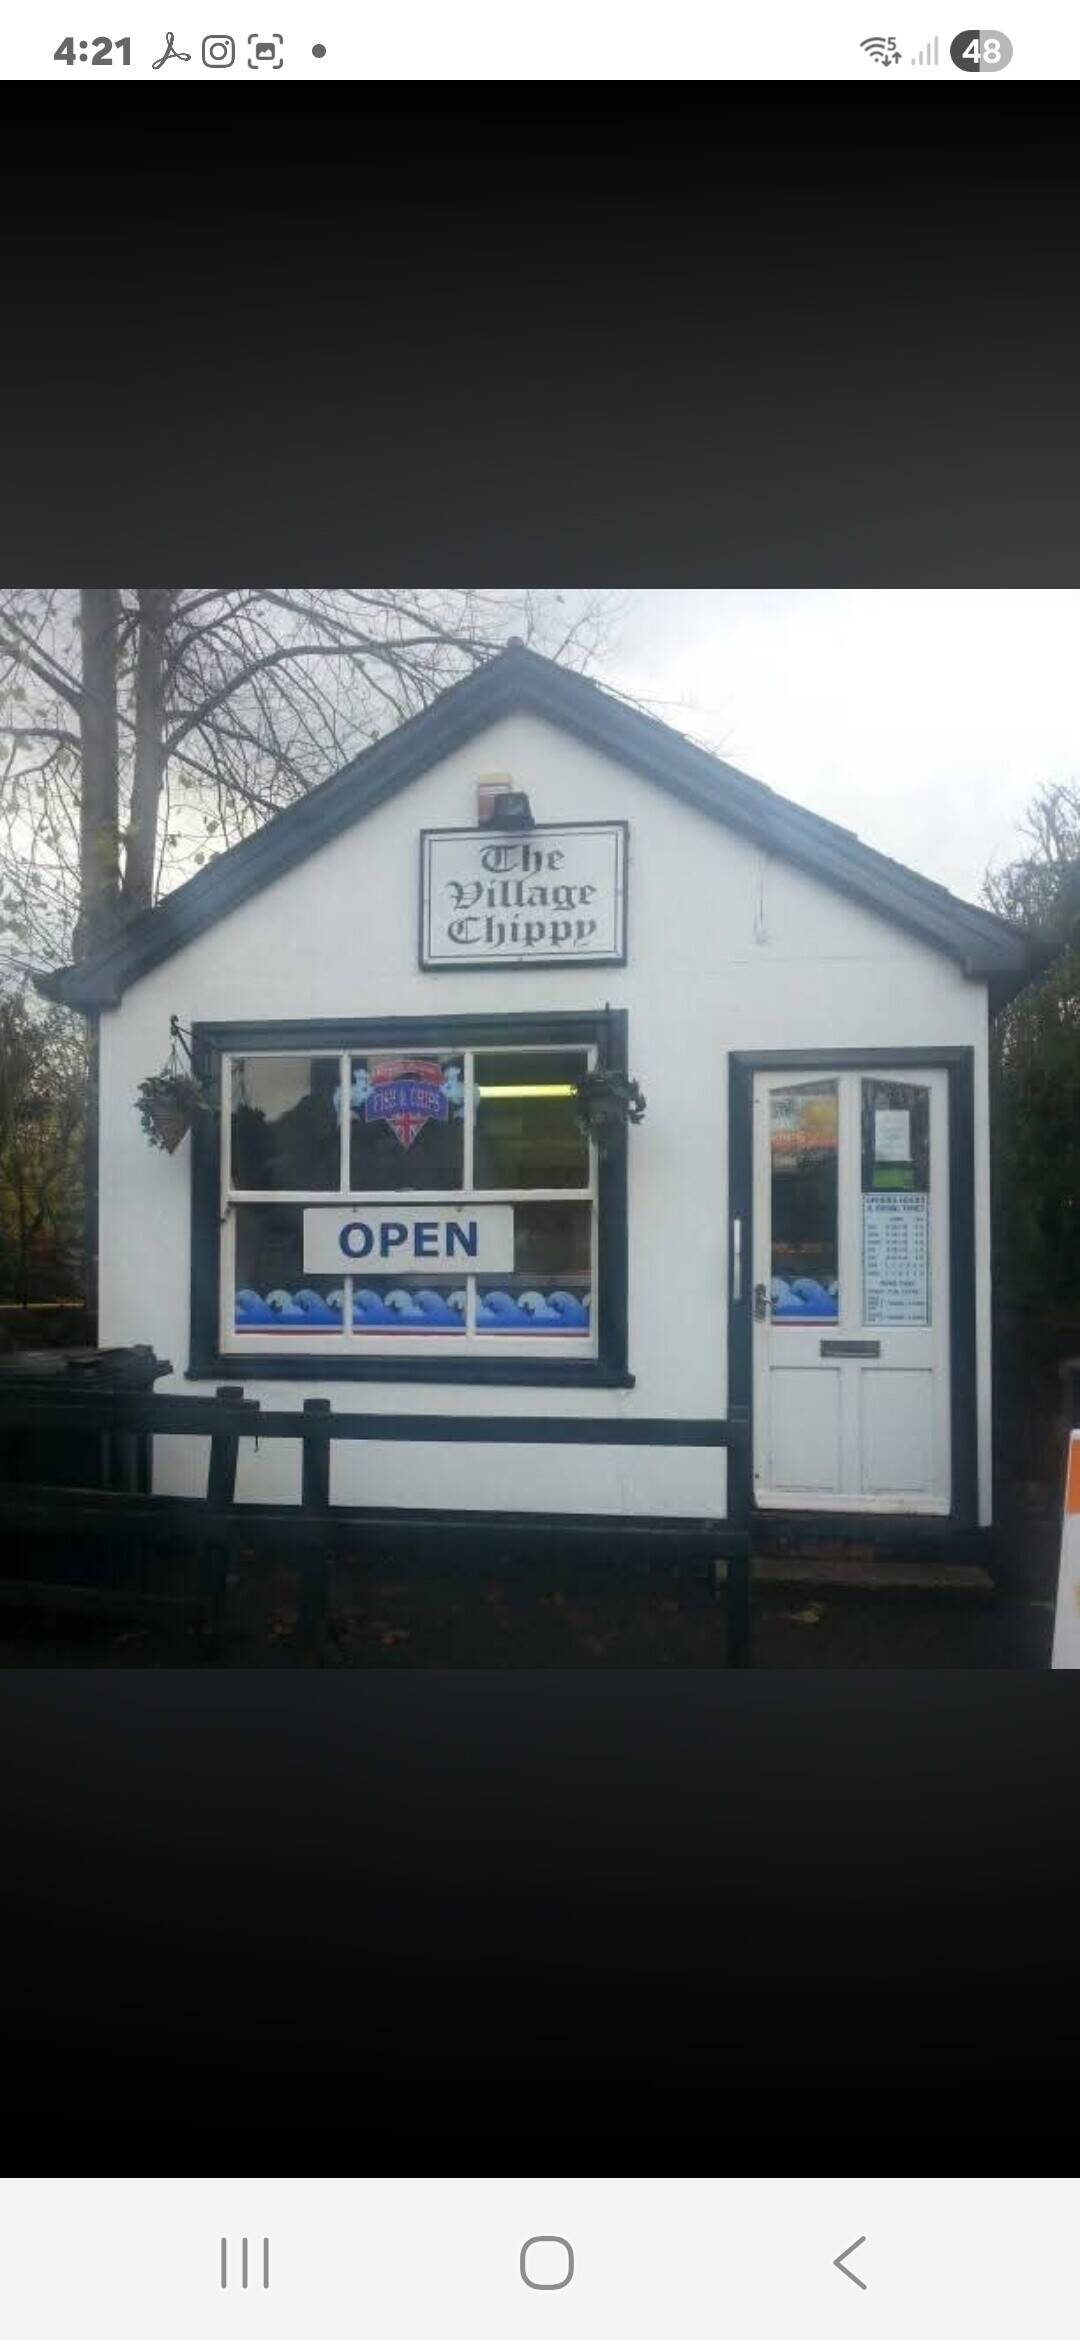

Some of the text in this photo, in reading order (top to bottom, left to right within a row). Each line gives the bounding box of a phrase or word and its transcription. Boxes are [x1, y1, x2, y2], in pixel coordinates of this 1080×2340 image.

[480, 843, 565, 876] The
[446, 878, 598, 911] Village
[447, 914, 597, 948] Chippy
[374, 1087, 397, 1112] FISH
[410, 1086, 441, 1112] CHIPS
[338, 1221, 478, 1258] OPEN
